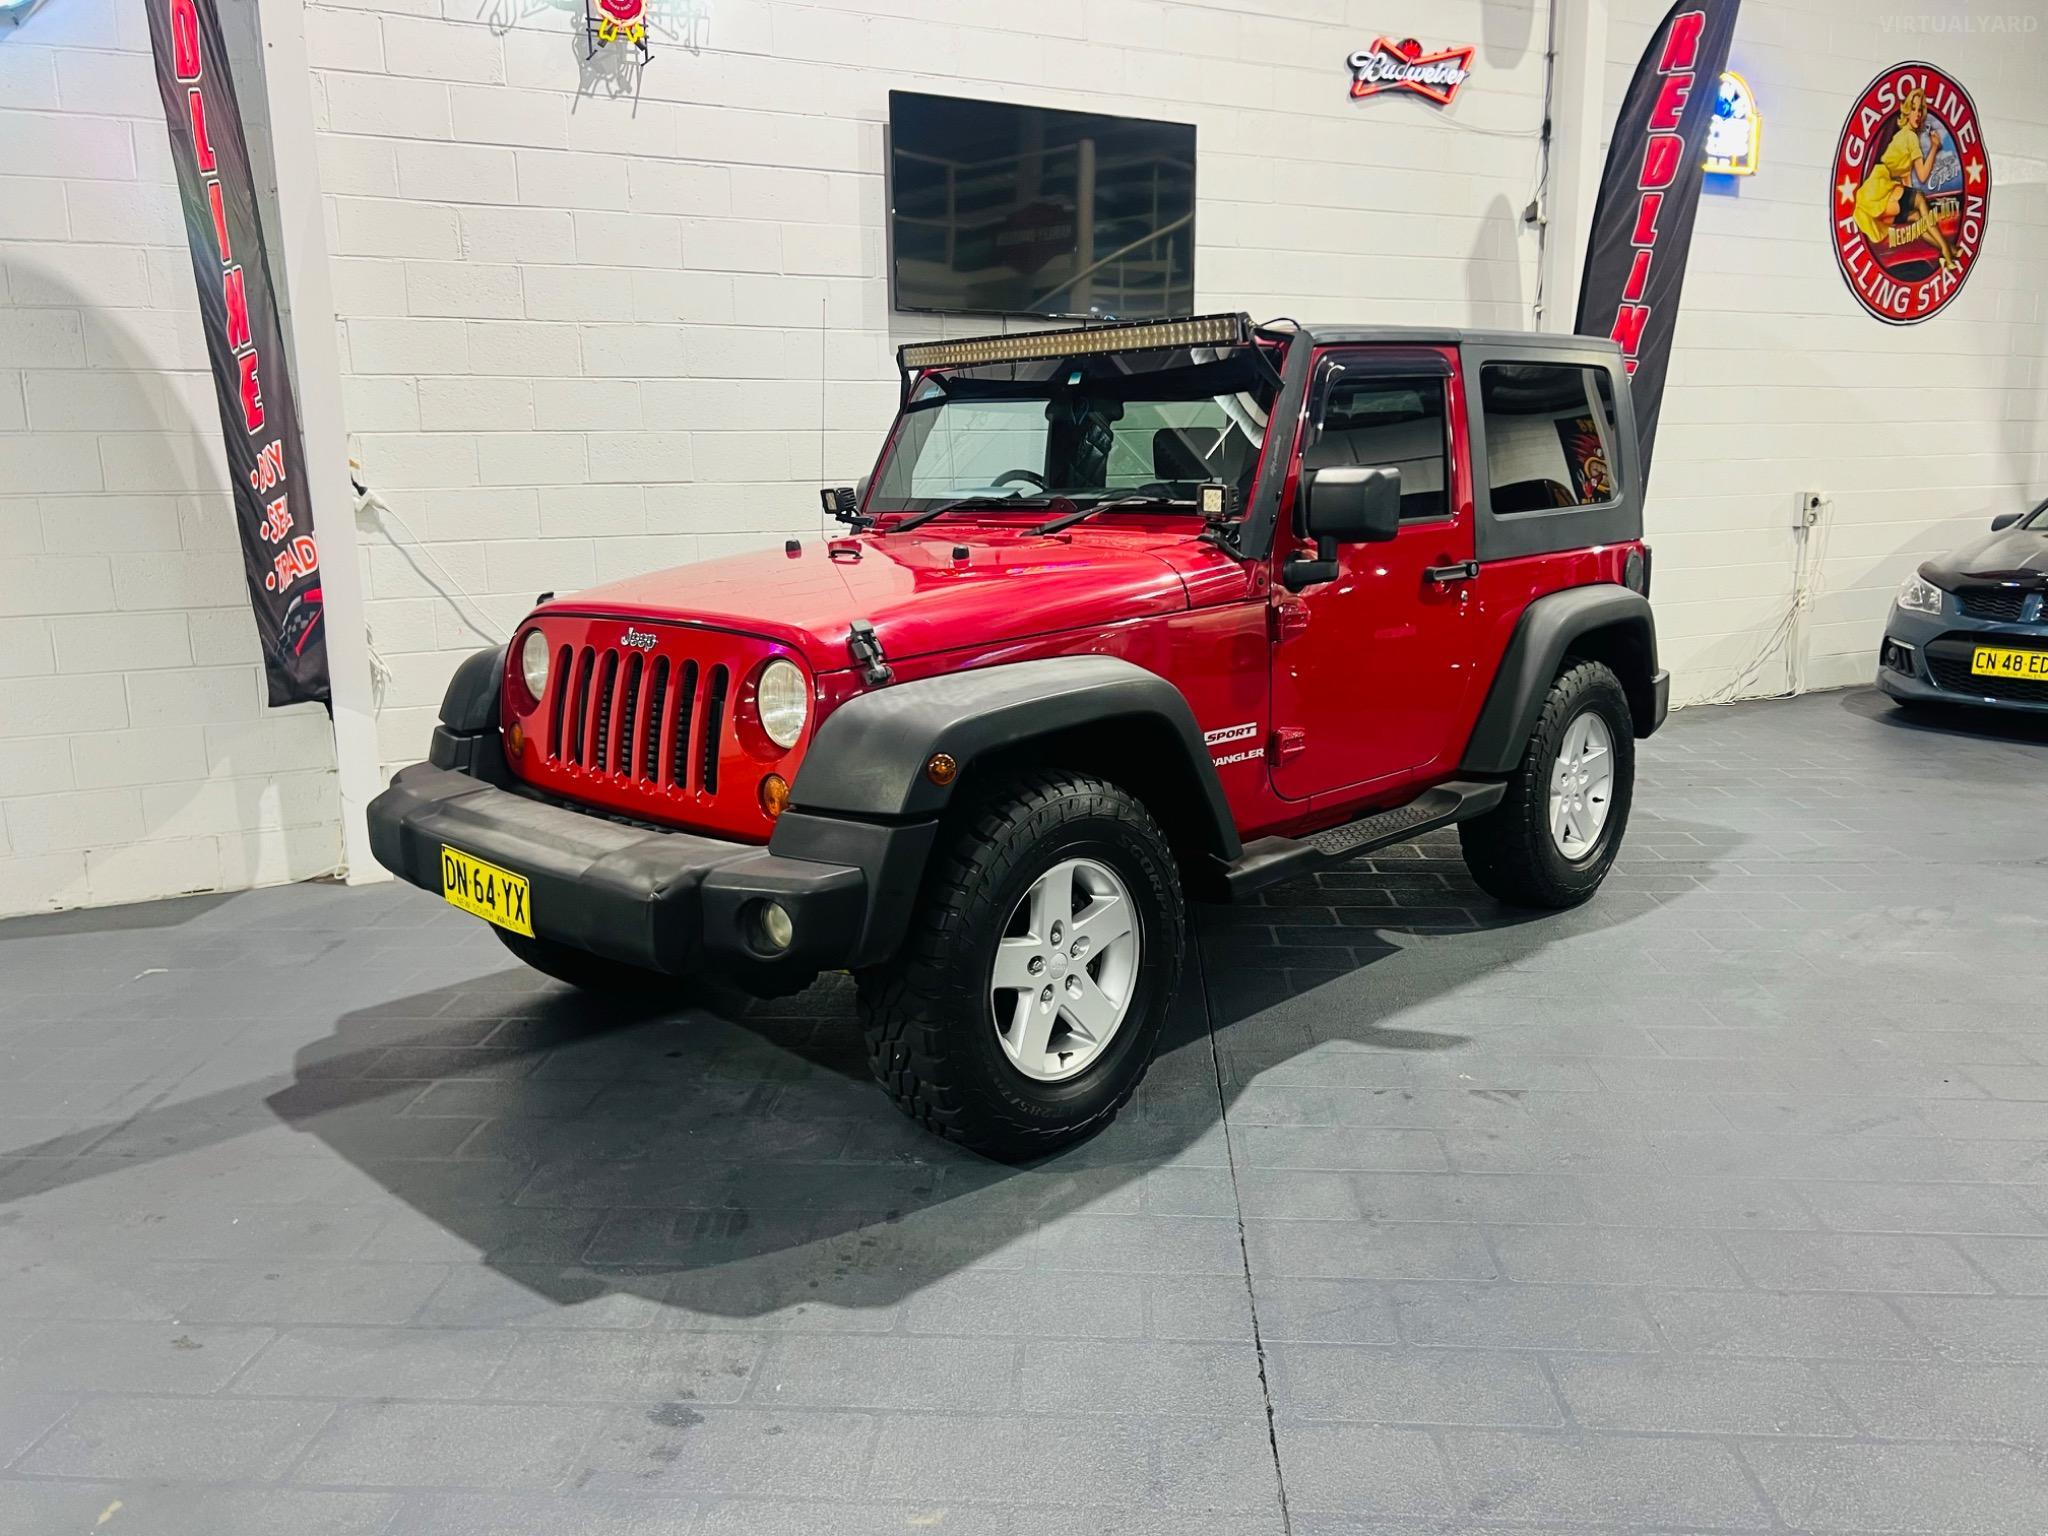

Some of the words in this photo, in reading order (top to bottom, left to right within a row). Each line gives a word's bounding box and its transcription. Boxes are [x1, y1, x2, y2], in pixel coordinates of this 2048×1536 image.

[1349, 50, 1467, 85] Budweiser
[1845, 74, 1977, 167] GASOLINE
[1839, 216, 1911, 313] FILLING
[1917, 195, 1983, 311] STATION
[620, 627, 658, 652] Jeep
[1976, 652, 1997, 670] CN
[2002, 654, 2023, 672] 48
[2029, 655, 2048, 674] ED
[1207, 726, 1254, 742] SPORT
[445, 854, 469, 898] DN
[473, 868, 496, 911] 64
[502, 878, 526, 925] YX
